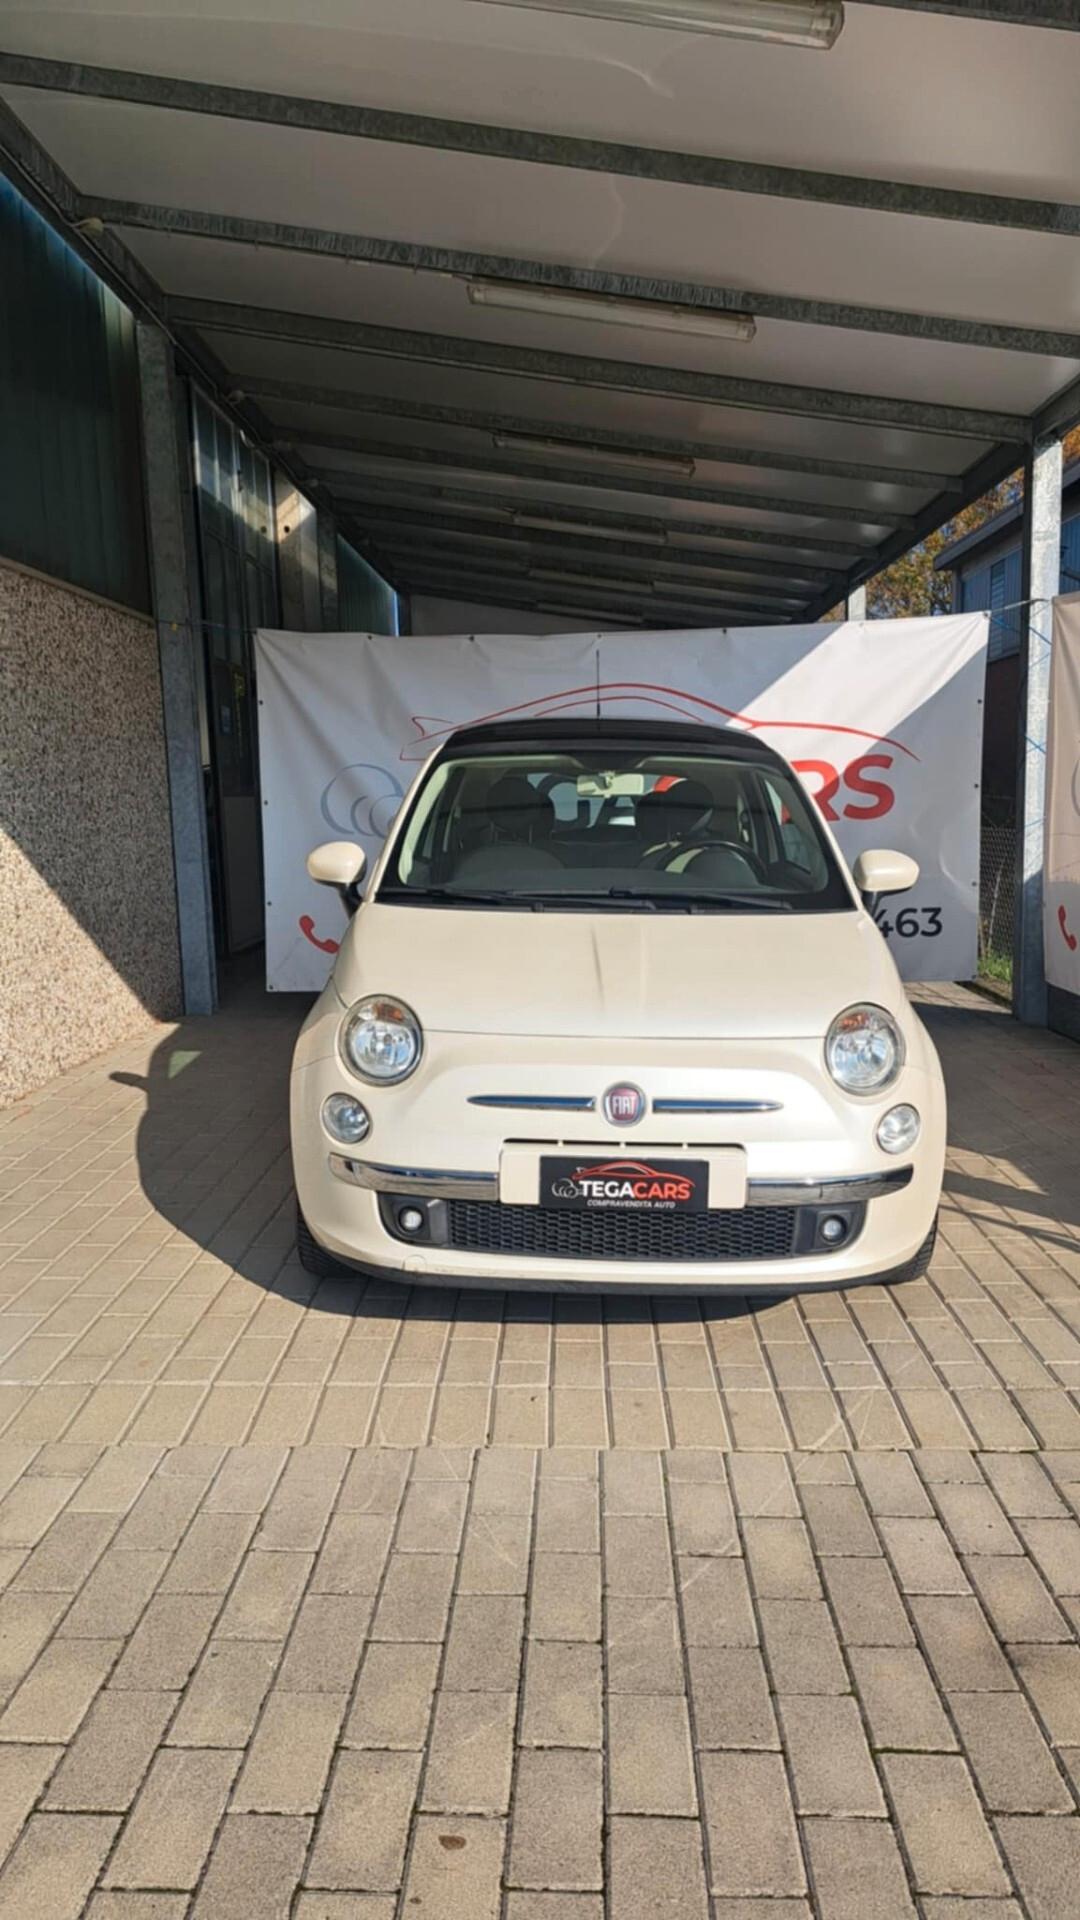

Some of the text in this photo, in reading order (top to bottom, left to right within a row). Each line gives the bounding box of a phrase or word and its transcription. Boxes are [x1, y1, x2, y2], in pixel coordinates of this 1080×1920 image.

[612, 1096, 635, 1115] FIAT
[579, 1181, 690, 1199] TEGACARS
[587, 1200, 676, 1209] COMPRAVENDITA AUTO
